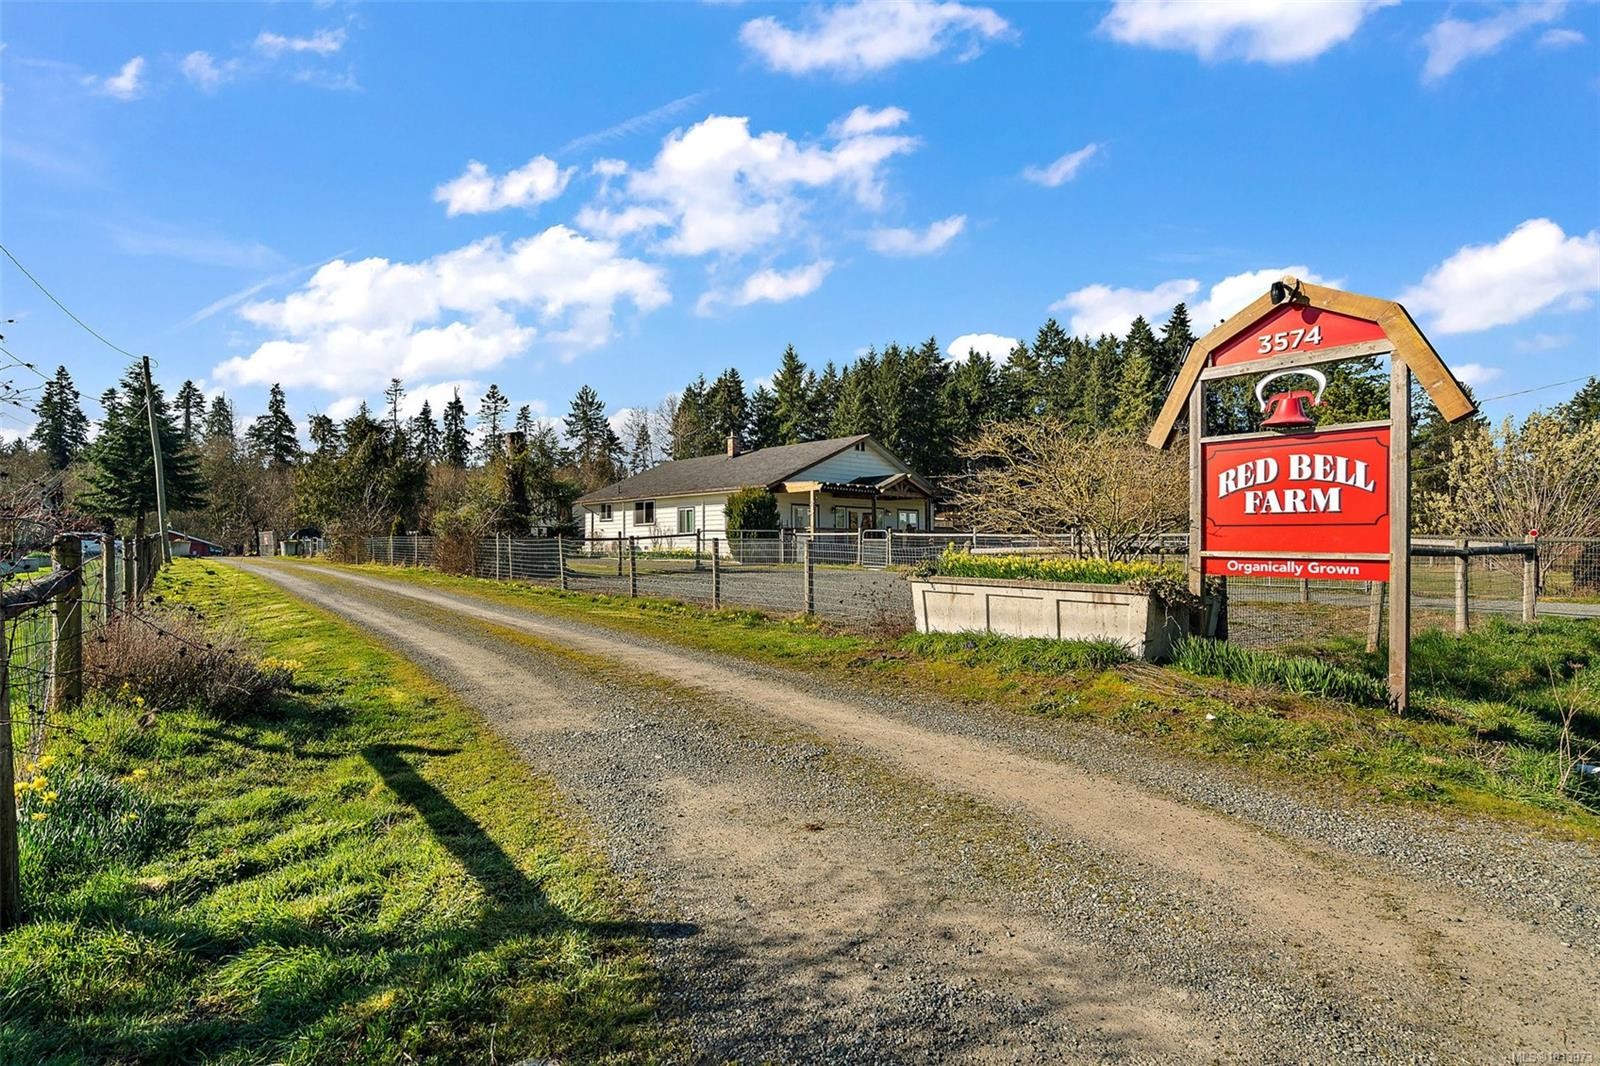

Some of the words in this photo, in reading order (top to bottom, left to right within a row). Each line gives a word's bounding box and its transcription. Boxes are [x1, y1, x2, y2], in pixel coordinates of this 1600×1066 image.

[1257, 325, 1322, 354] 3574
[1218, 457, 1278, 498] RED
[1288, 453, 1375, 492] BELL
[1244, 487, 1341, 514] FARM
[1227, 560, 1303, 576] Organically
[1307, 562, 1360, 575] Grown
